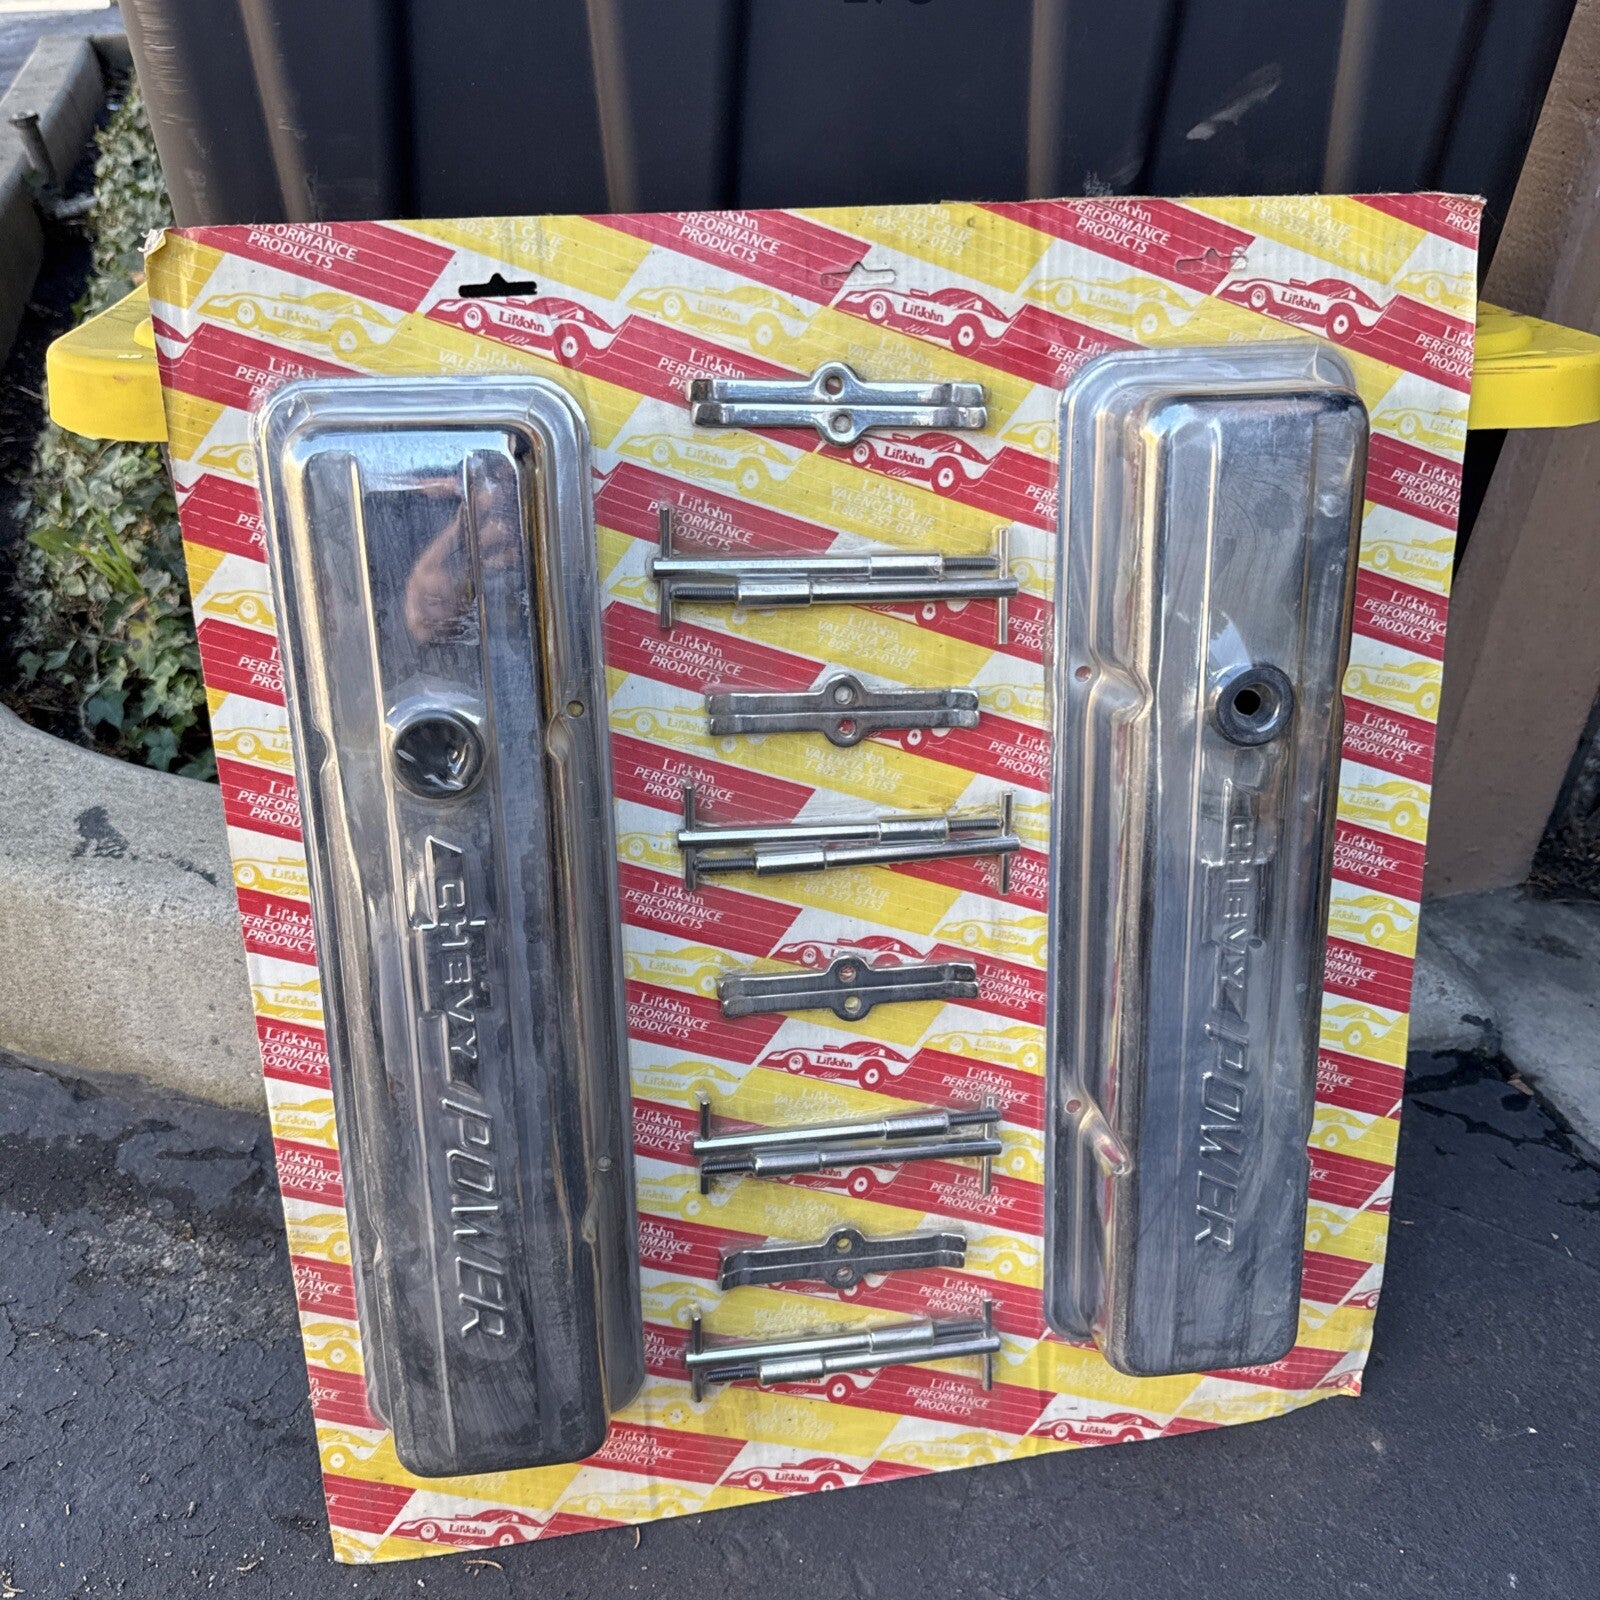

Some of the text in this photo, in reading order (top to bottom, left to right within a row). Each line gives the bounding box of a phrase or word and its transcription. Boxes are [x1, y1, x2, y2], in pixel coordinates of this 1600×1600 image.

[252, 223, 358, 261] FORMANCE
[679, 225, 758, 263] PRODUCTS
[1076, 218, 1149, 254] PRODUCTS
[247, 232, 336, 270] PRODUCTS
[818, 620, 878, 646] VALENCIA
[1370, 615, 1434, 643] PRODUCTS
[639, 638, 743, 676] PERFORMANCE
[650, 655, 721, 684] PRODUCTS
[1342, 737, 1406, 762] PRODUCTS
[1343, 722, 1424, 755] ERFORMANCE
[625, 890, 723, 922] PERFORMANCE
[635, 906, 703, 930] PRODUCTS
[941, 1076, 1029, 1103] PERFORMANCE
[1195, 1022, 1248, 1252] POWER
[929, 1182, 1017, 1209] PERFORMANCE
[937, 1195, 999, 1217] PRODUCTS
[441, 1097, 506, 1338] POWER
[907, 1386, 989, 1408] PERFORMANCE
[914, 1400, 972, 1416] PRODUCTS
